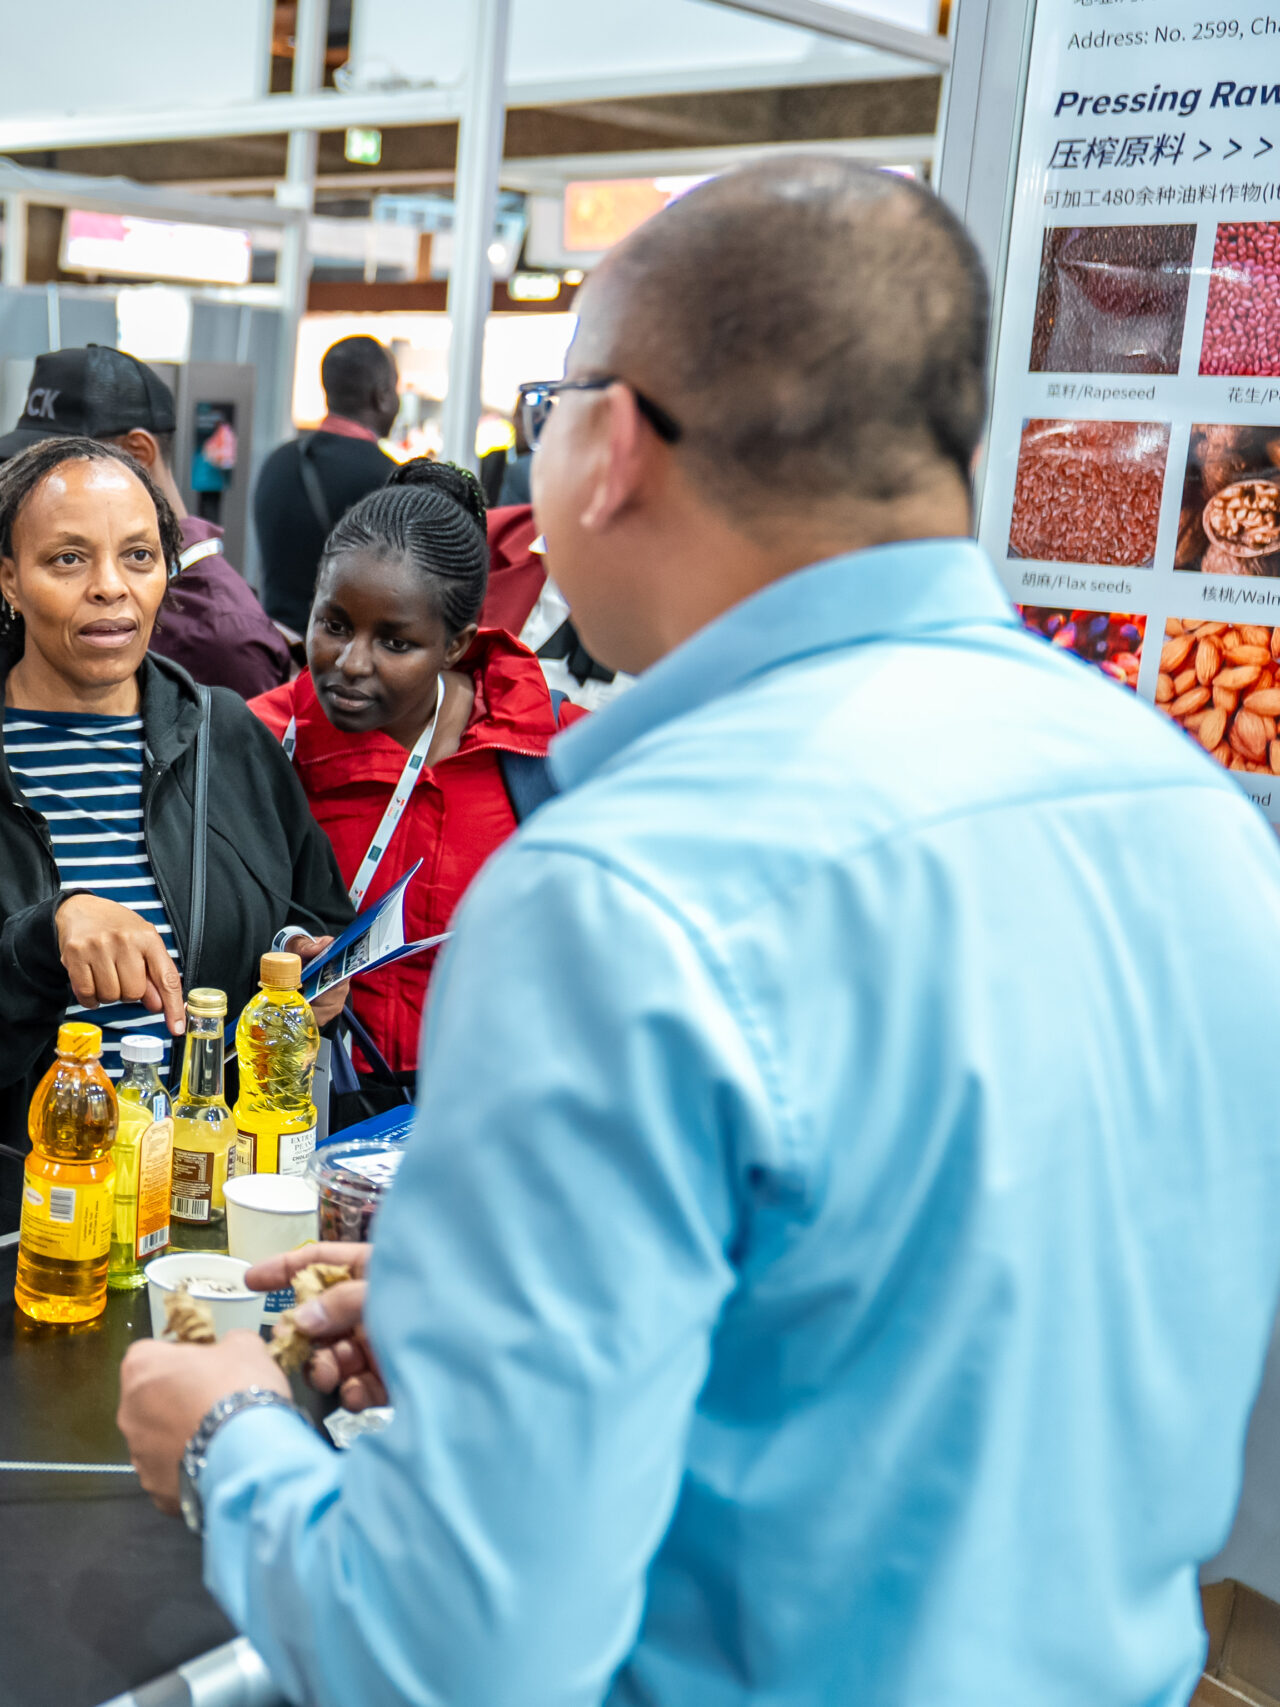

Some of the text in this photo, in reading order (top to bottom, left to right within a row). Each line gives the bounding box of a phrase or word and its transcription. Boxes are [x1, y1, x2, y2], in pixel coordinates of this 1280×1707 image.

[1067, 16, 1280, 50] Address: No. 2599, Ch
[1054, 84, 1202, 117] Pressing
[1046, 132, 1186, 169] 压榨原料
[1228, 386, 1280, 406] 花生/P
[1090, 579, 1132, 594] seeds
